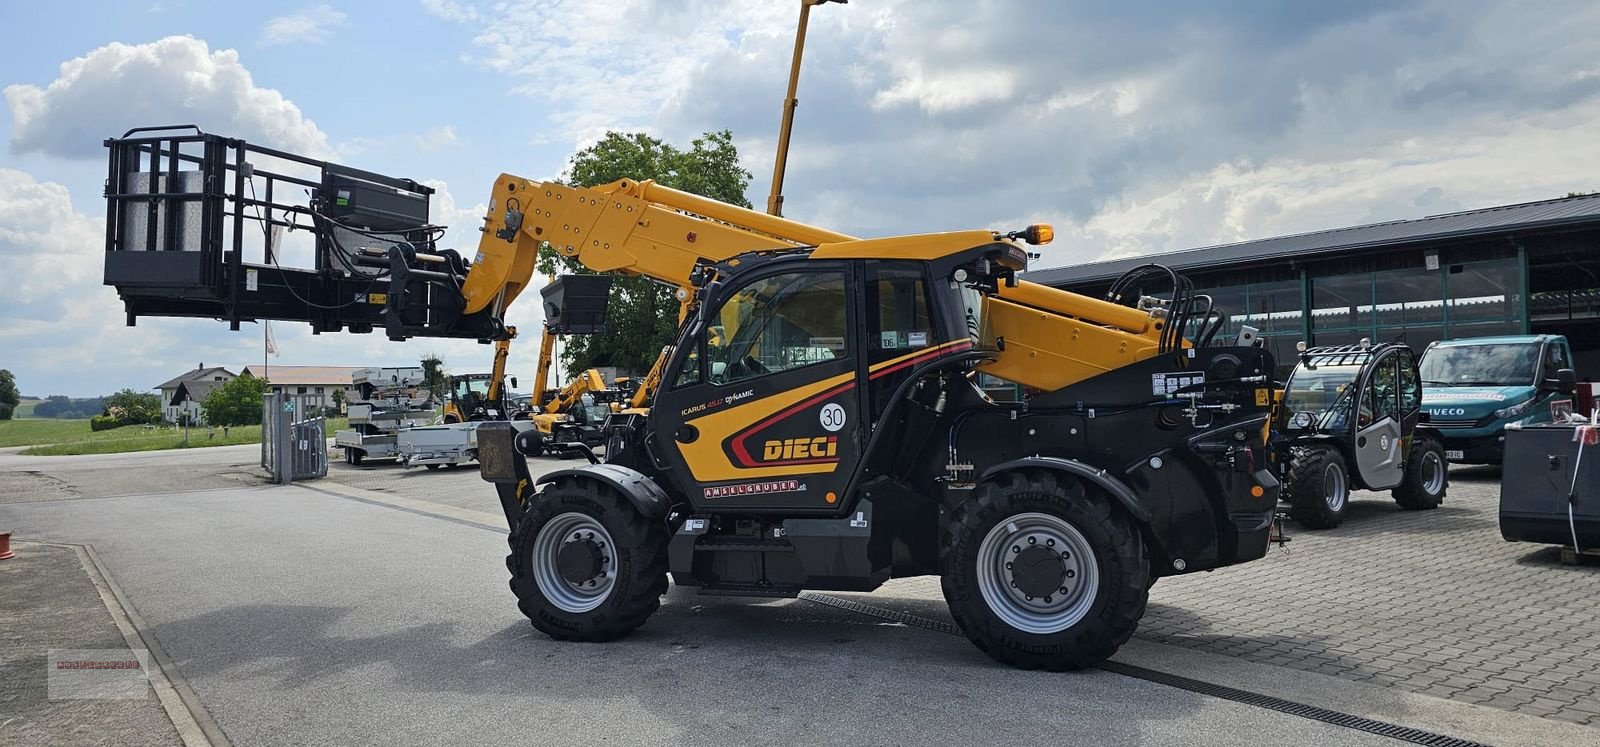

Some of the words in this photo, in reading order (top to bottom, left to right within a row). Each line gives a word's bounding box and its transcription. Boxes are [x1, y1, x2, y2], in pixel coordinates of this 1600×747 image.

[681, 403, 707, 416] ICARUS
[1429, 408, 1465, 416] IVECO
[823, 408, 843, 426] 30
